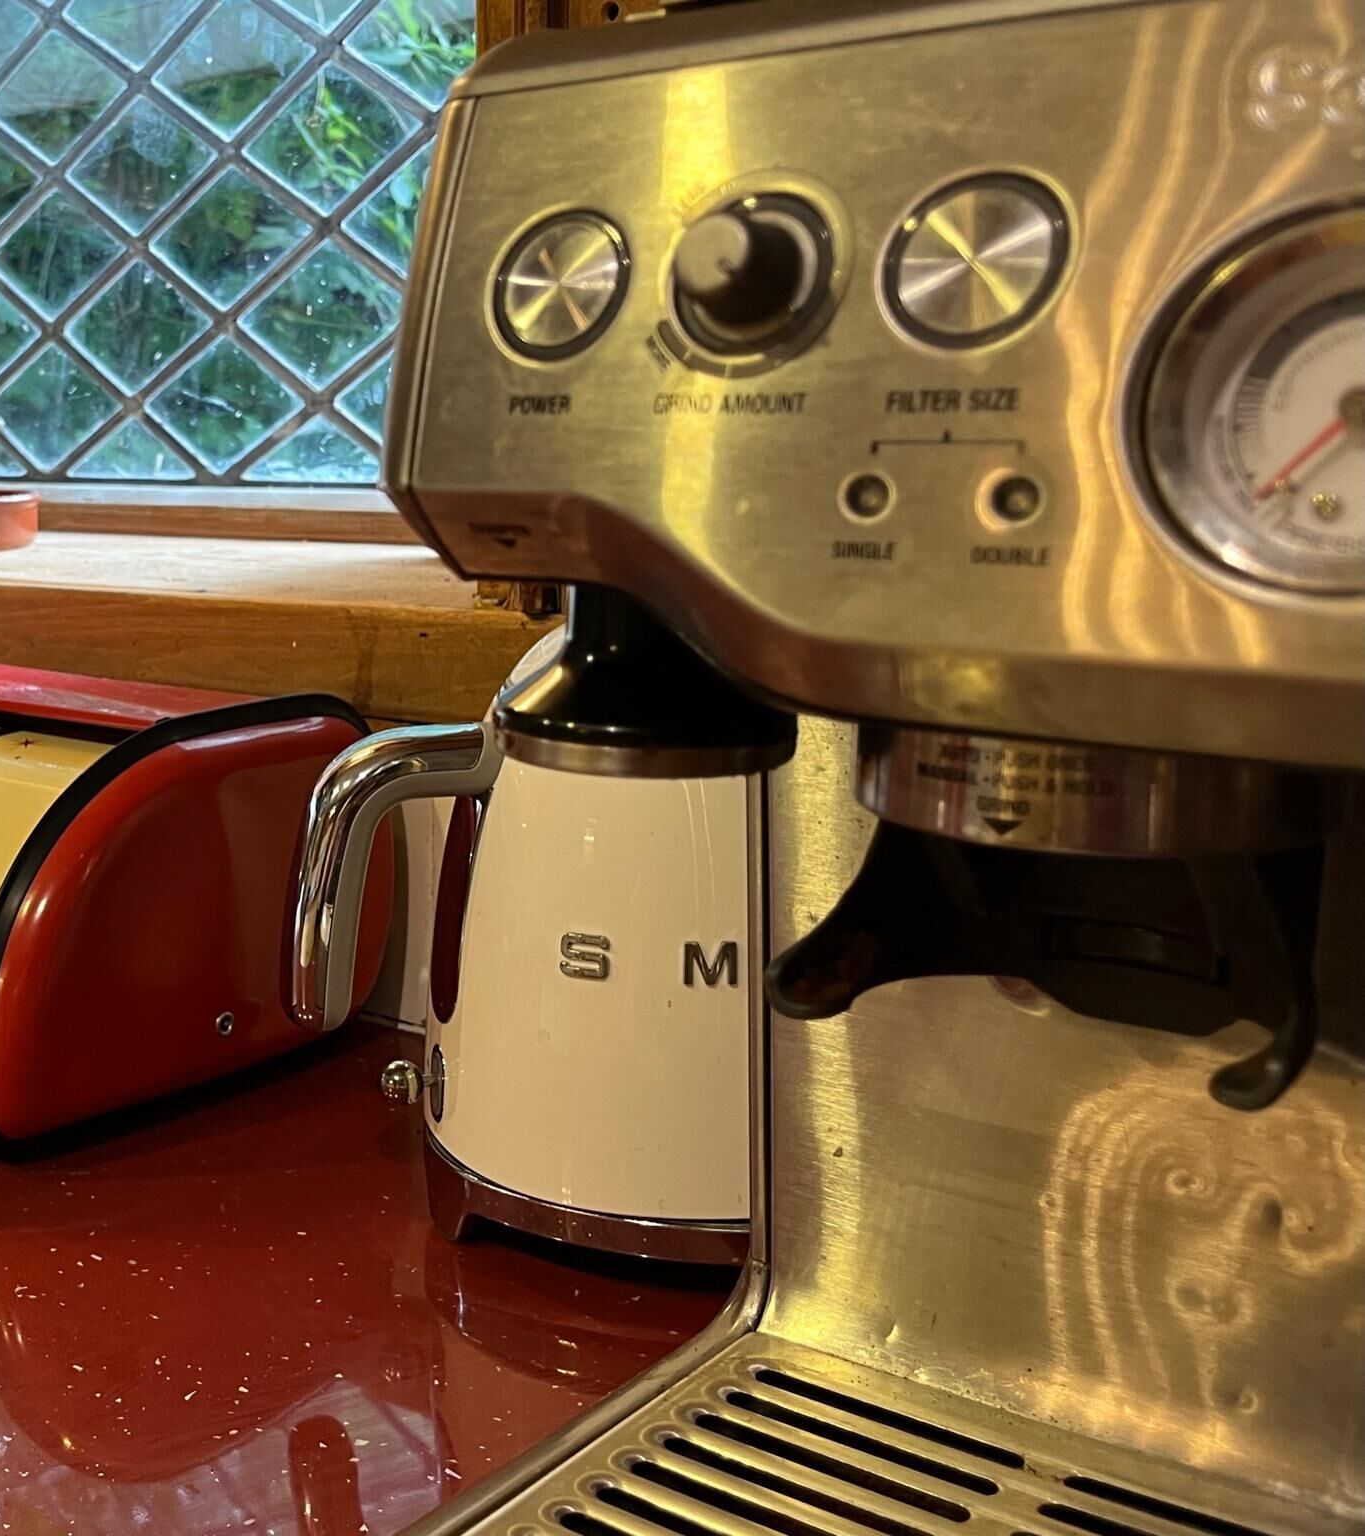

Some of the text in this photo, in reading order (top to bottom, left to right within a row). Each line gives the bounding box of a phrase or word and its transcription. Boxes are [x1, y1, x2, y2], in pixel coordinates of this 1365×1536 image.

[509, 394, 572, 416] POWER
[717, 391, 808, 415] AMOUNT
[884, 388, 1021, 413] FILTER SIZE
[832, 541, 898, 562] SINGLE
[971, 546, 1050, 567] DOUBLE
